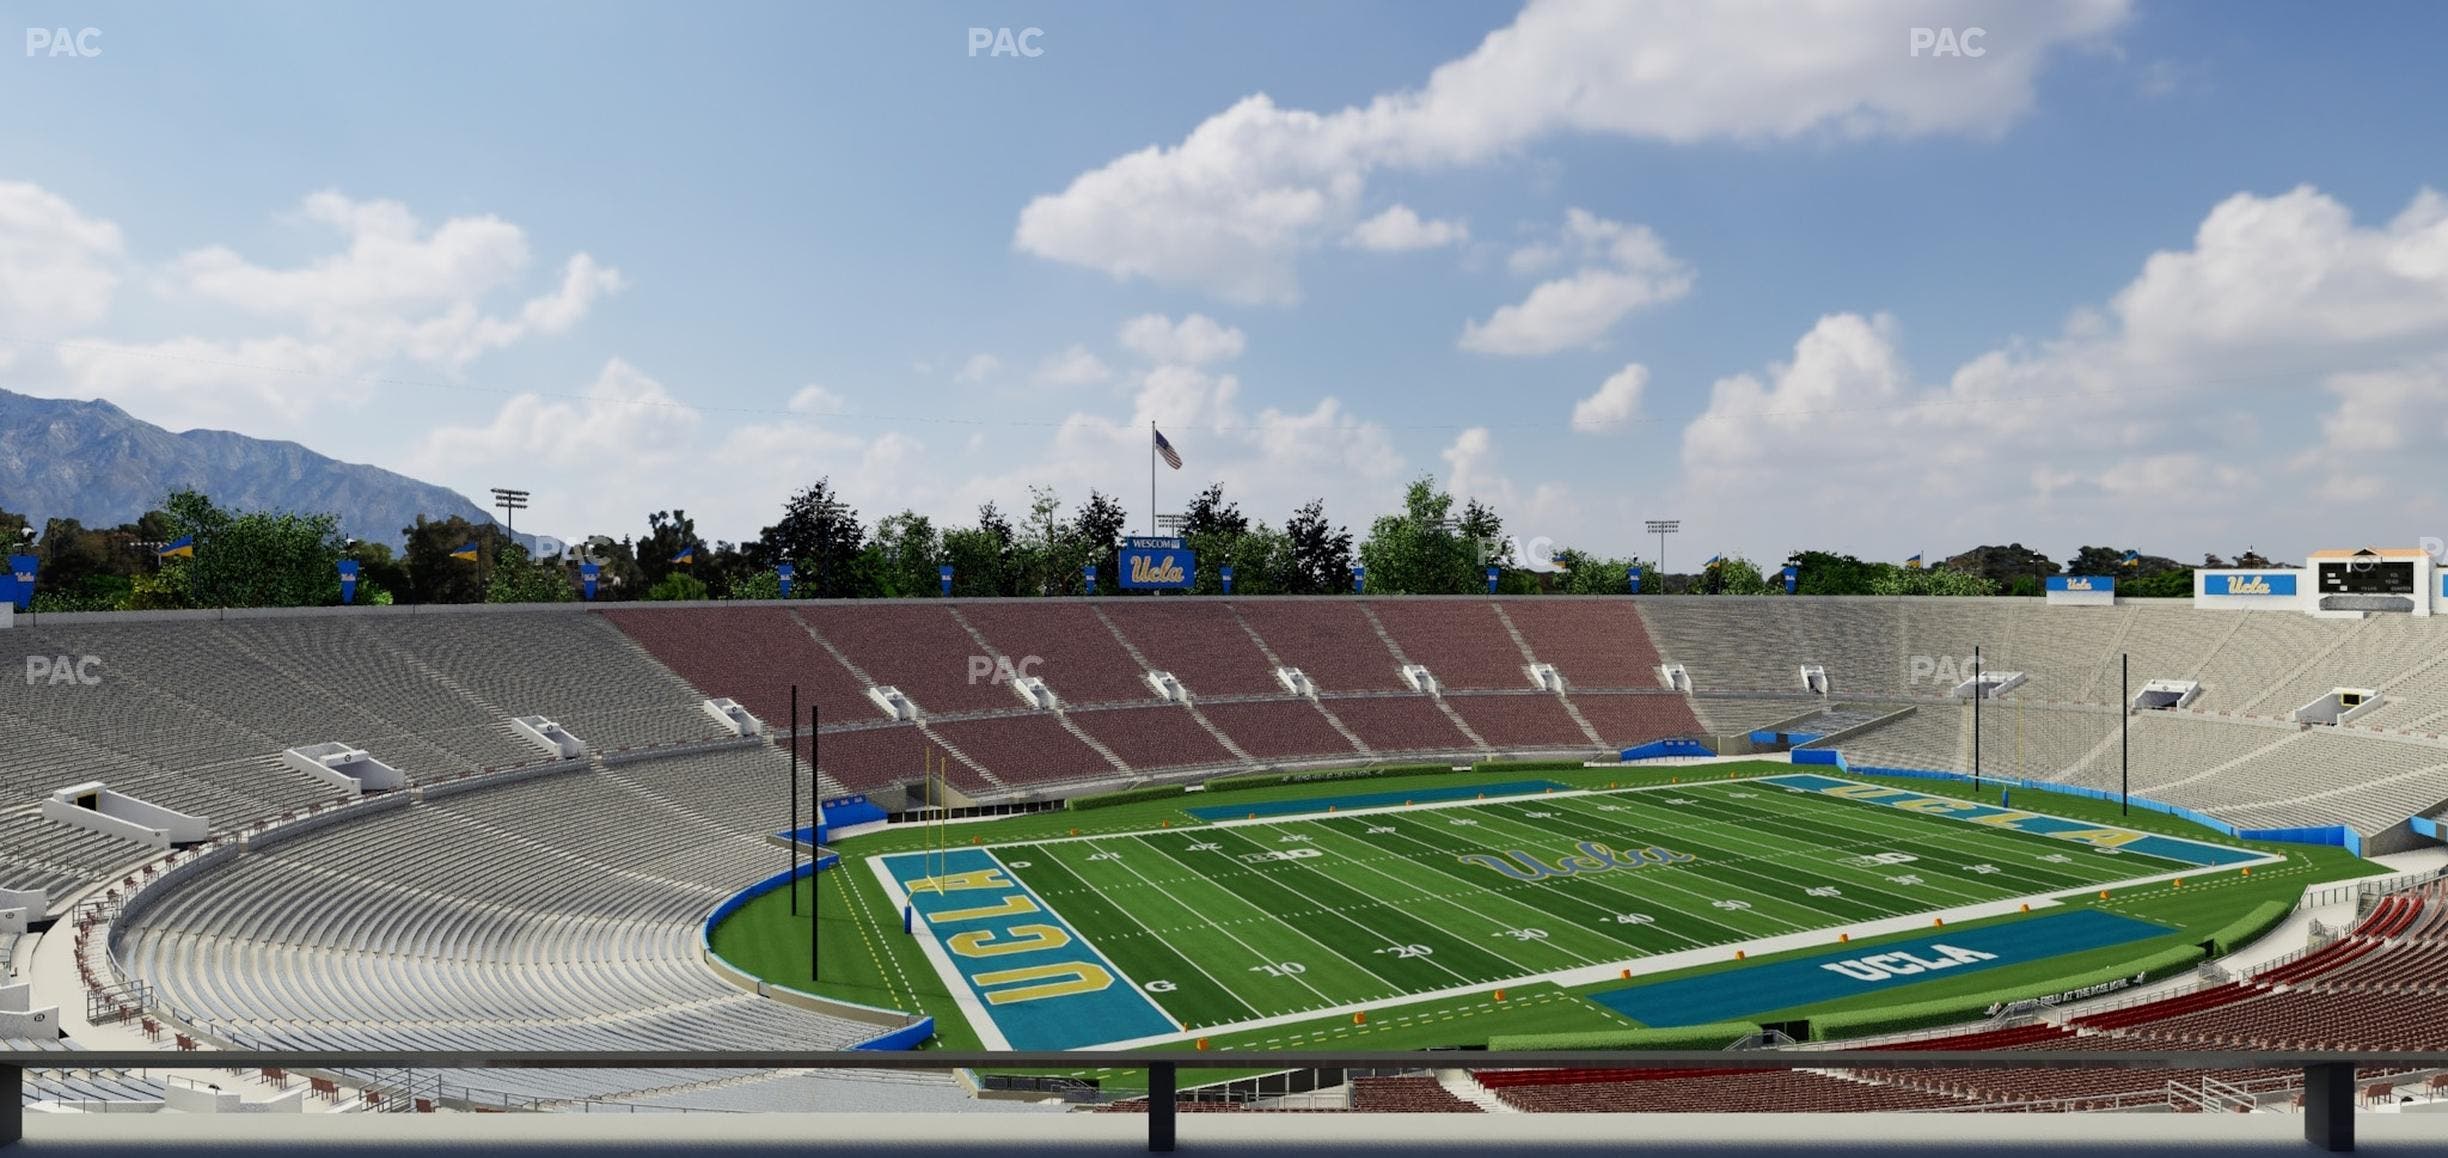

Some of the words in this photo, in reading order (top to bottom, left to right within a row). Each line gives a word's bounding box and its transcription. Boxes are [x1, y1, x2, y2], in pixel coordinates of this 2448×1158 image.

[1132, 540, 1170, 548] WESCOM
[1131, 556, 1184, 583] Ucla
[1821, 784, 2149, 848] UCLA
[1457, 842, 1696, 880] Ucla
[1616, 912, 1655, 925] 40
[904, 868, 1116, 1006] UCLA
[1505, 927, 1549, 942] 30
[1387, 944, 1433, 958] 20
[1257, 961, 1307, 978] 10
[1819, 943, 2000, 982] UCLA
[1144, 979, 1178, 993] G
